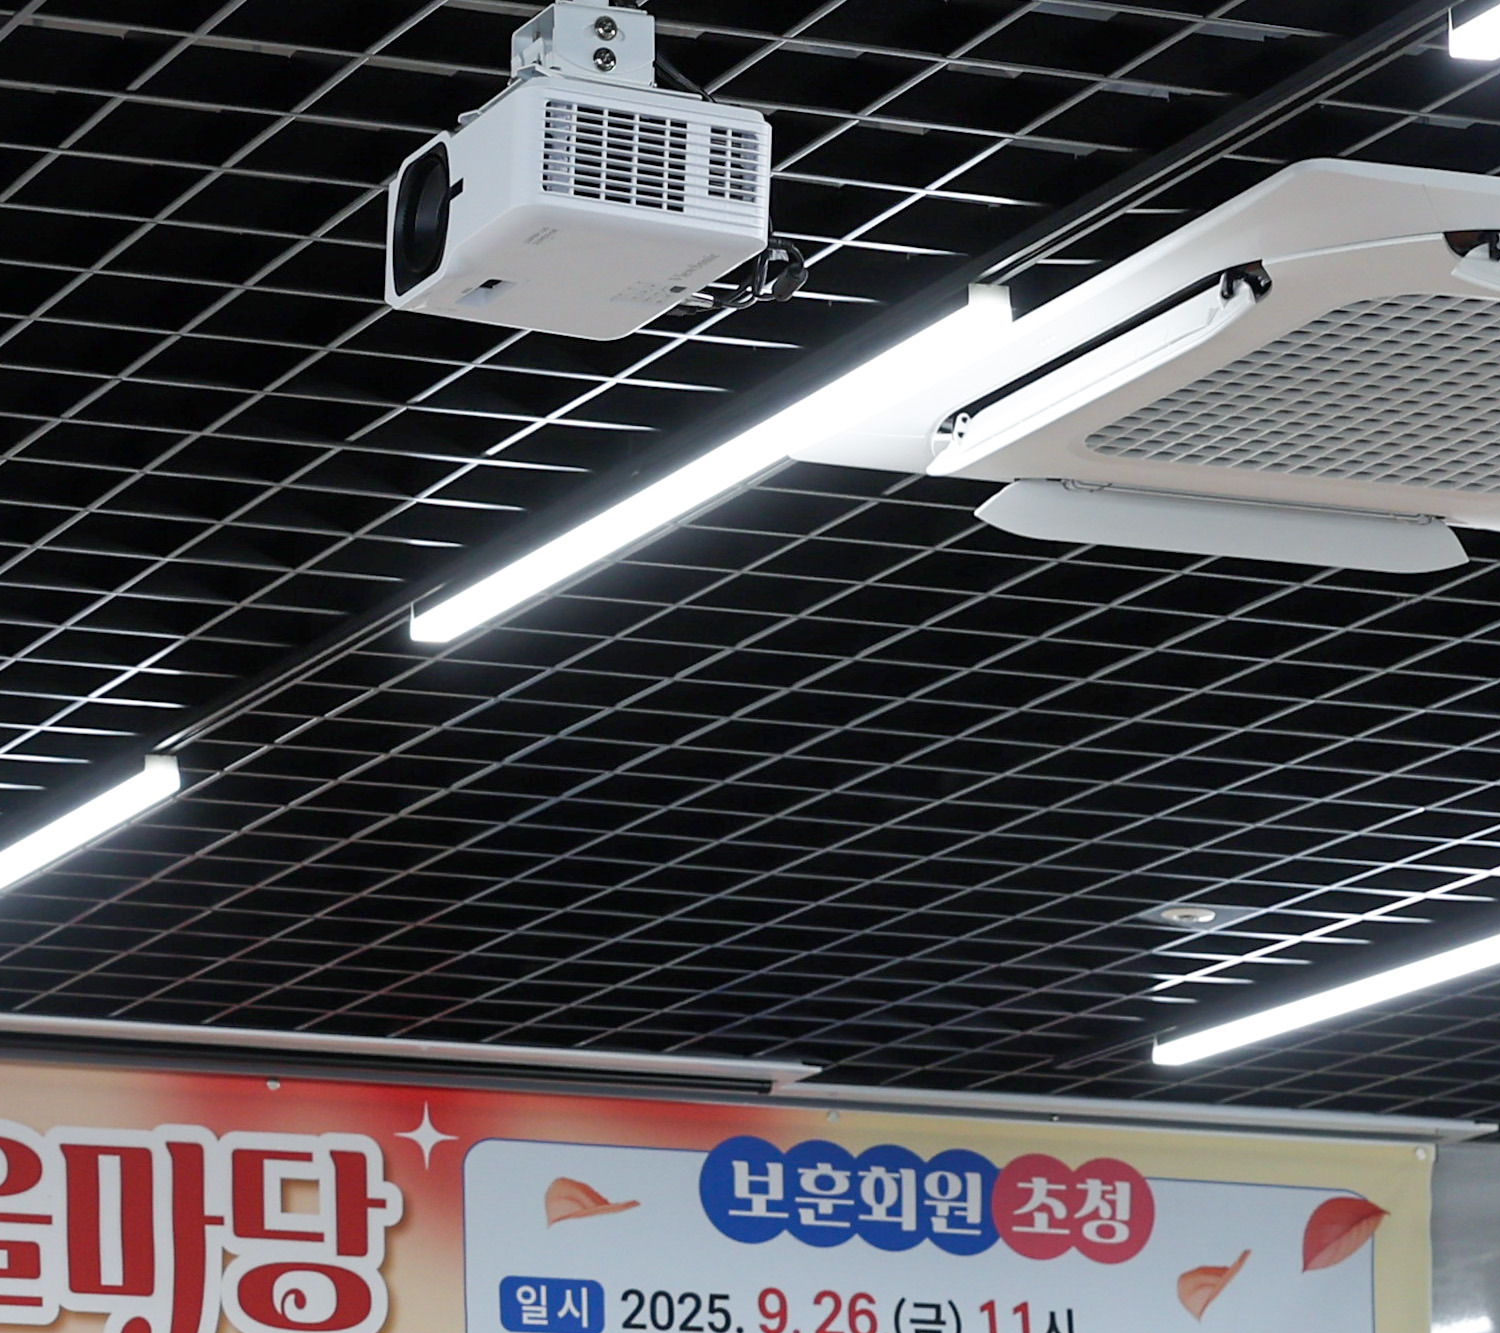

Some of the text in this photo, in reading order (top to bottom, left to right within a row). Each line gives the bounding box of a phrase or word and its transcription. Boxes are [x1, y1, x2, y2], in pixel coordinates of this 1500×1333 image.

[728, 1158, 1132, 1246] 보훈회원 초청
[514, 1285, 590, 1328] 일시
